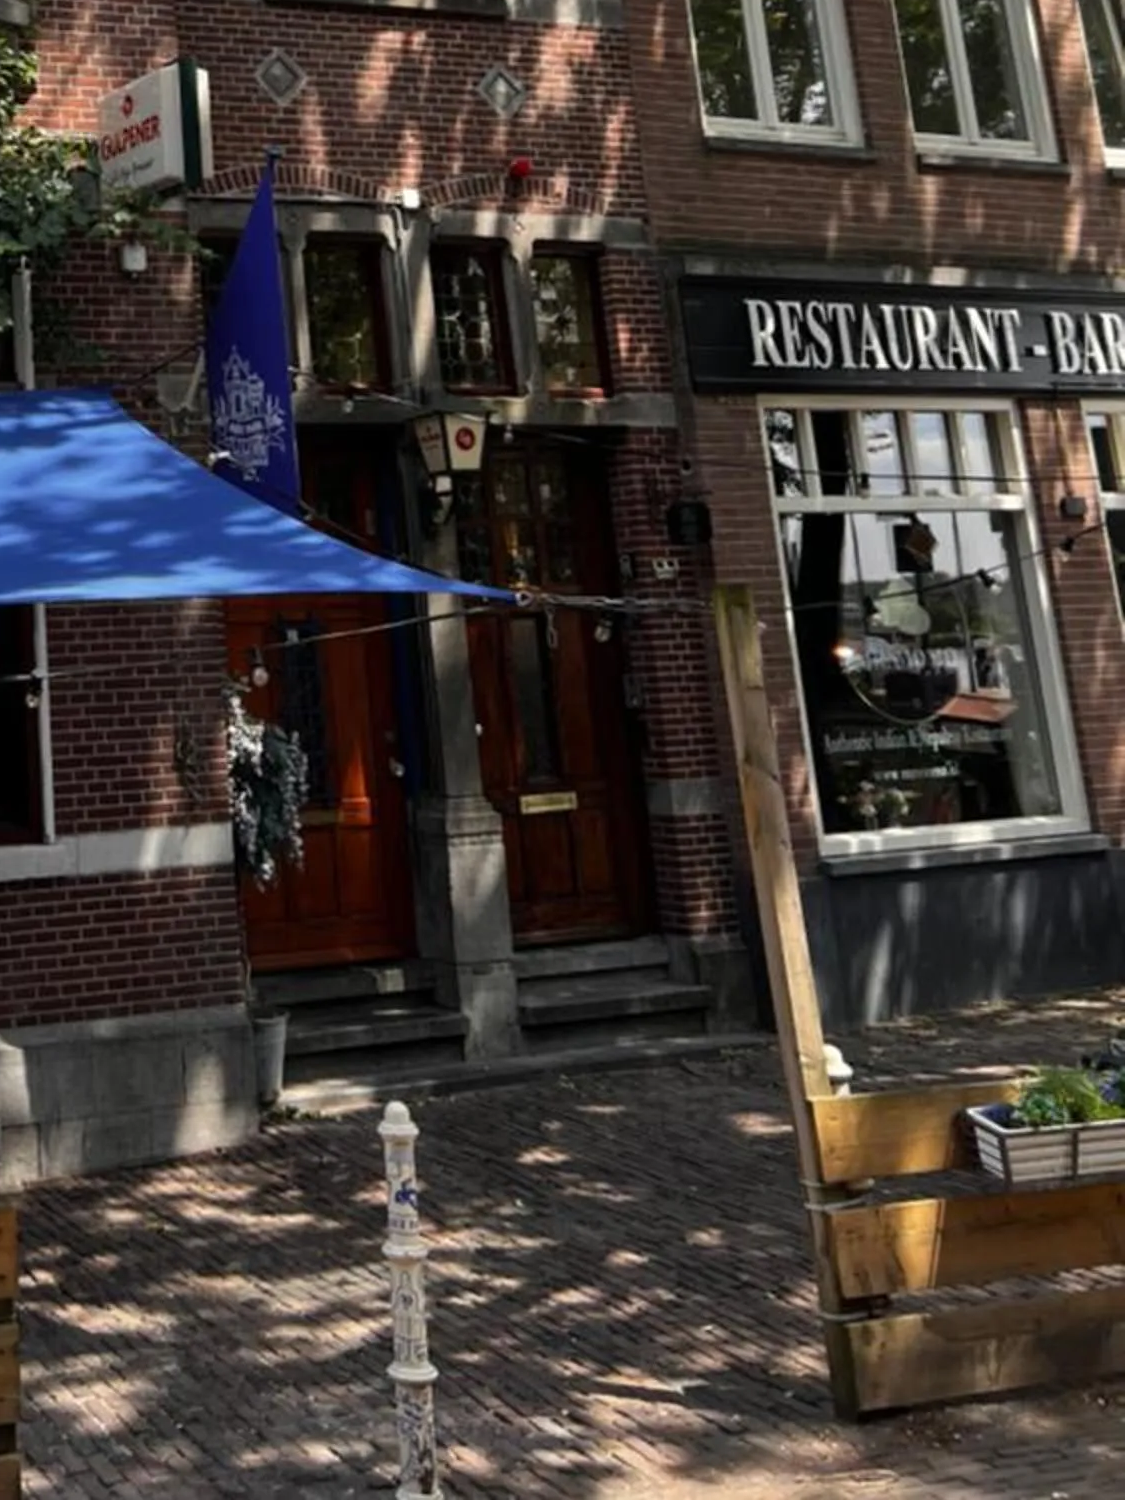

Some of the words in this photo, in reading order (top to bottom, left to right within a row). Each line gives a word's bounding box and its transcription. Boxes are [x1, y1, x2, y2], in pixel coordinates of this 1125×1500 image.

[101, 114, 161, 162] GULPENER
[745, 298, 1023, 373] RESTAURANT
[1047, 310, 1125, 375] BAR
